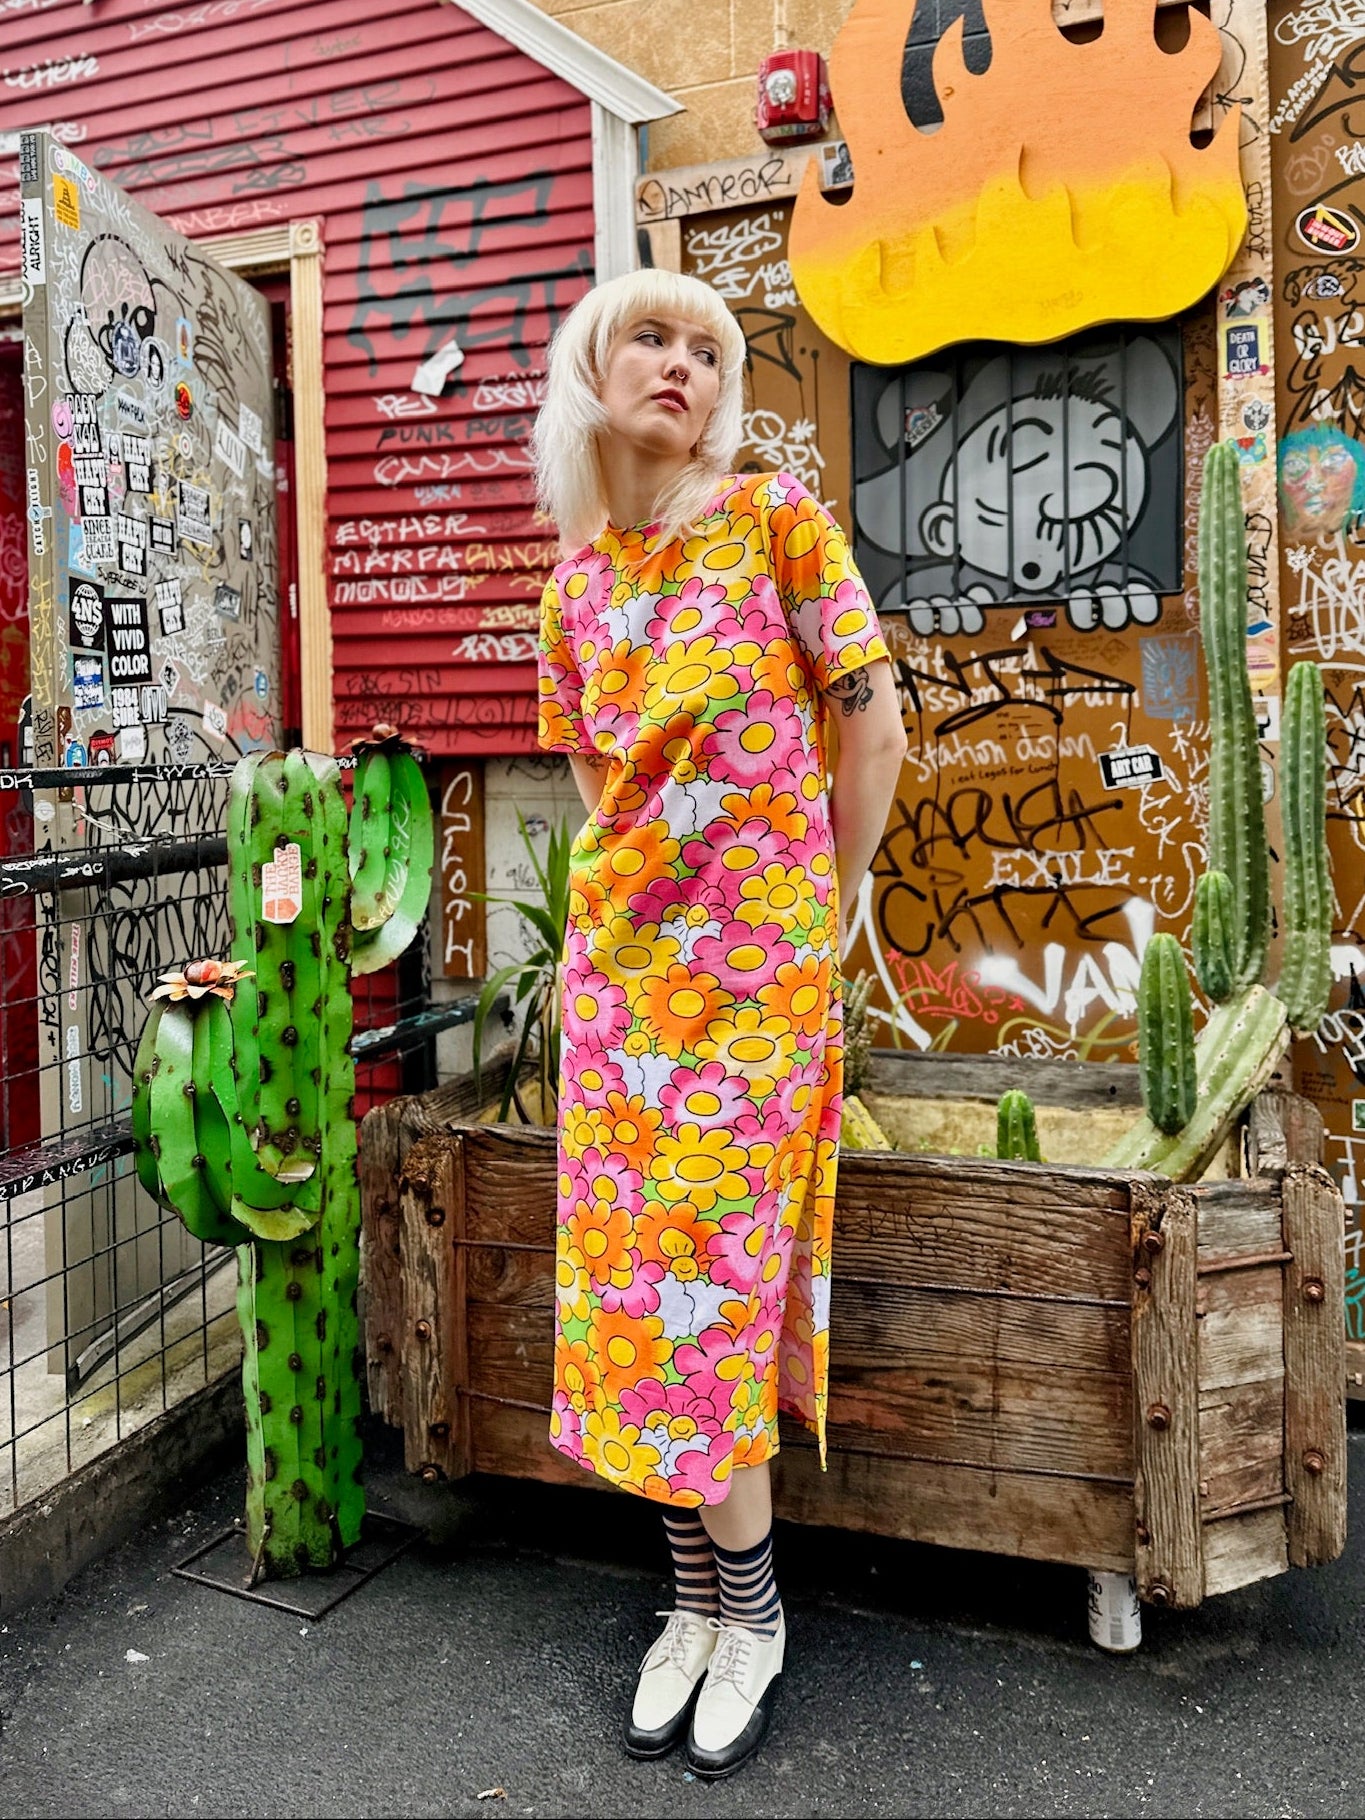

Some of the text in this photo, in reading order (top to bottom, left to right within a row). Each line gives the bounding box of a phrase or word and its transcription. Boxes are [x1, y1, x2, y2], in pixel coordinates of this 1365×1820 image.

[29, 214, 41, 272] ALRIGHT
[1229, 332, 1256, 345] DEATH
[1236, 344, 1249, 358] OR
[1229, 357, 1258, 373] GLORY
[376, 422, 455, 449] PUNK
[84, 519, 112, 535] SINCE
[335, 513, 487, 545] ESTHER
[332, 546, 464, 574] MARFA
[111, 604, 141, 625] WITH
[112, 629, 145, 651] VIVID
[111, 654, 149, 677] COLOR
[113, 706, 140, 727] SURE
[958, 769, 975, 784] eat
[978, 767, 1008, 782] Legos
[1010, 765, 1025, 776] for
[1110, 758, 1132, 779] ART
[1131, 754, 1154, 774] CAR
[984, 847, 1135, 891] EXILE
